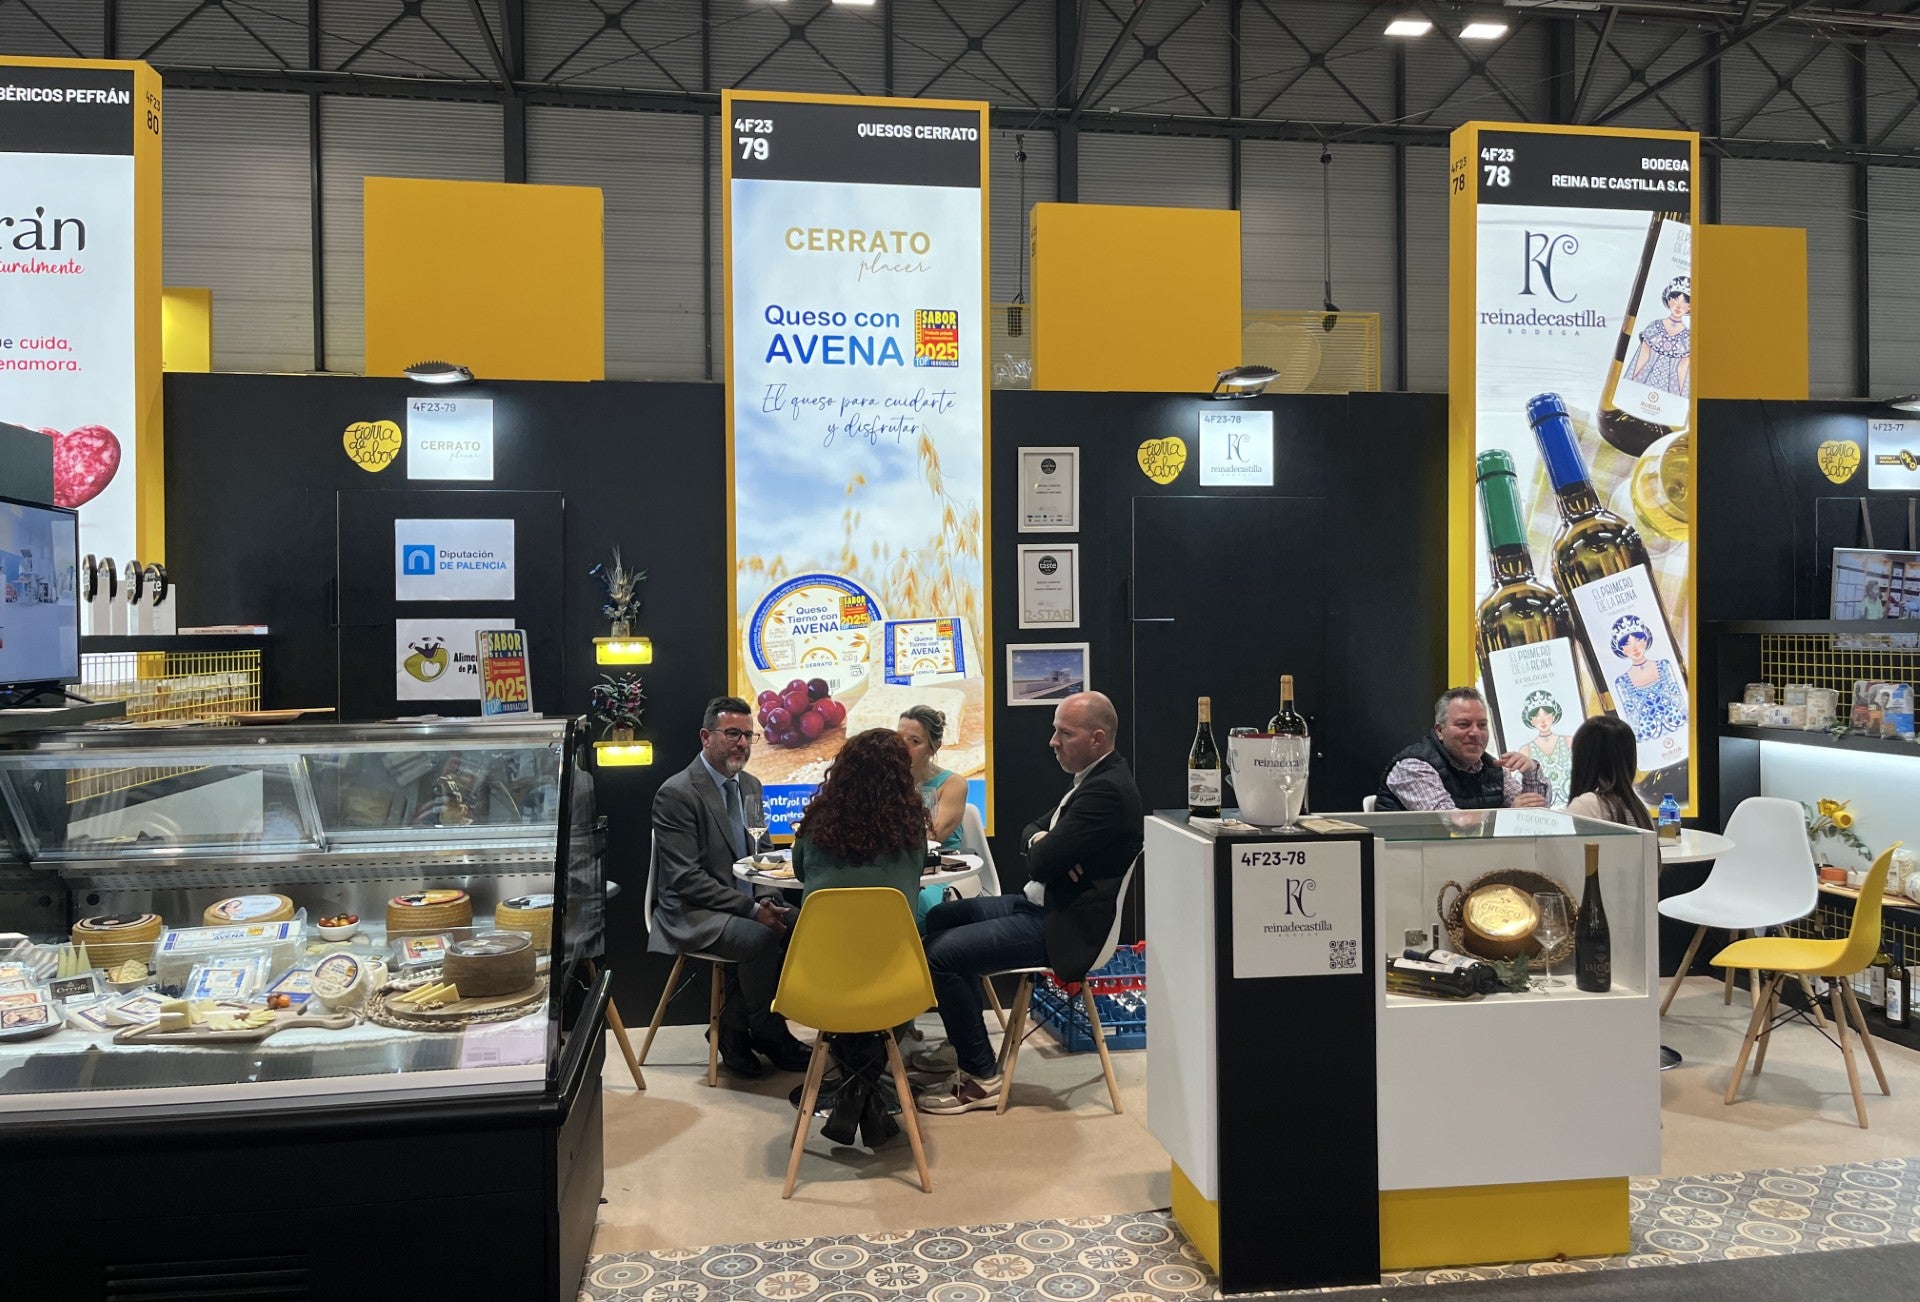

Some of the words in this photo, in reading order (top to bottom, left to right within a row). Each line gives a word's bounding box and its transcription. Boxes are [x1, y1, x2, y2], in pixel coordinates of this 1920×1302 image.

[66, 88, 129, 104] PEFRÁN
[145, 91, 161, 112] 4F23
[147, 110, 159, 135] 80
[734, 118, 773, 134] 4F23
[857, 123, 912, 138] QUESOS
[914, 126, 978, 141] CERRATO
[738, 137, 769, 161] 79
[1480, 147, 1515, 162] 4F23
[1451, 156, 1467, 174] 4F23
[1641, 157, 1690, 171] BODEGA
[1452, 173, 1465, 195] 78
[1484, 165, 1511, 187] 78
[1551, 174, 1590, 188] REINA
[1590, 176, 1607, 188] DE
[1608, 177, 1666, 191] CASTILLA
[1666, 180, 1690, 192] S.C.
[785, 227, 931, 255] CERRATO
[857, 252, 931, 282] placer
[1518, 230, 1579, 303] RC
[764, 304, 847, 327] Queso
[854, 312, 900, 328] con
[922, 310, 957, 325] SABOR
[1480, 308, 1607, 328] reinadecastilla
[1507, 328, 1580, 337] BODEGA
[19, 336, 73, 352] cuida,
[764, 333, 905, 367] AVENA
[915, 342, 958, 361] 2025
[0, 360, 82, 371] enamora.
[413, 402, 456, 413] 4F23-79
[762, 383, 787, 413] El
[791, 394, 836, 421] queso
[840, 394, 880, 417] para
[884, 388, 956, 414] cuidarte
[1204, 415, 1242, 424] 4F23-78
[1873, 423, 1905, 432] 4F23-77
[345, 425, 399, 442] tierra
[823, 421, 840, 448] y
[844, 413, 919, 445] disfrutar
[420, 440, 481, 451] CERRATO
[1210, 464, 1263, 473] reinadecastilla
[439, 550, 494, 560] Diputación
[439, 562, 453, 570] DE
[456, 561, 507, 570] PALENCIA
[1600, 577, 1634, 597] PRIMERO
[1615, 588, 1637, 606] REINA
[787, 615, 818, 624] Tierno
[820, 613, 838, 621] con
[796, 606, 828, 615] Queso
[841, 614, 868, 625] 2025
[792, 621, 839, 635] AVENA
[488, 632, 522, 652] SABOR
[453, 652, 478, 662] Alime
[911, 646, 941, 656] AVENA
[1517, 645, 1551, 660] PRIMERO
[458, 665, 466, 673] de
[805, 661, 833, 669] CERRATO
[1530, 657, 1552, 671] REINA
[486, 676, 527, 702] 2025
[1241, 851, 1306, 866] 4F23-78
[1284, 878, 1317, 918] RC
[1481, 902, 1521, 919] CHUSCO
[1263, 920, 1333, 933] reinadecastilla
